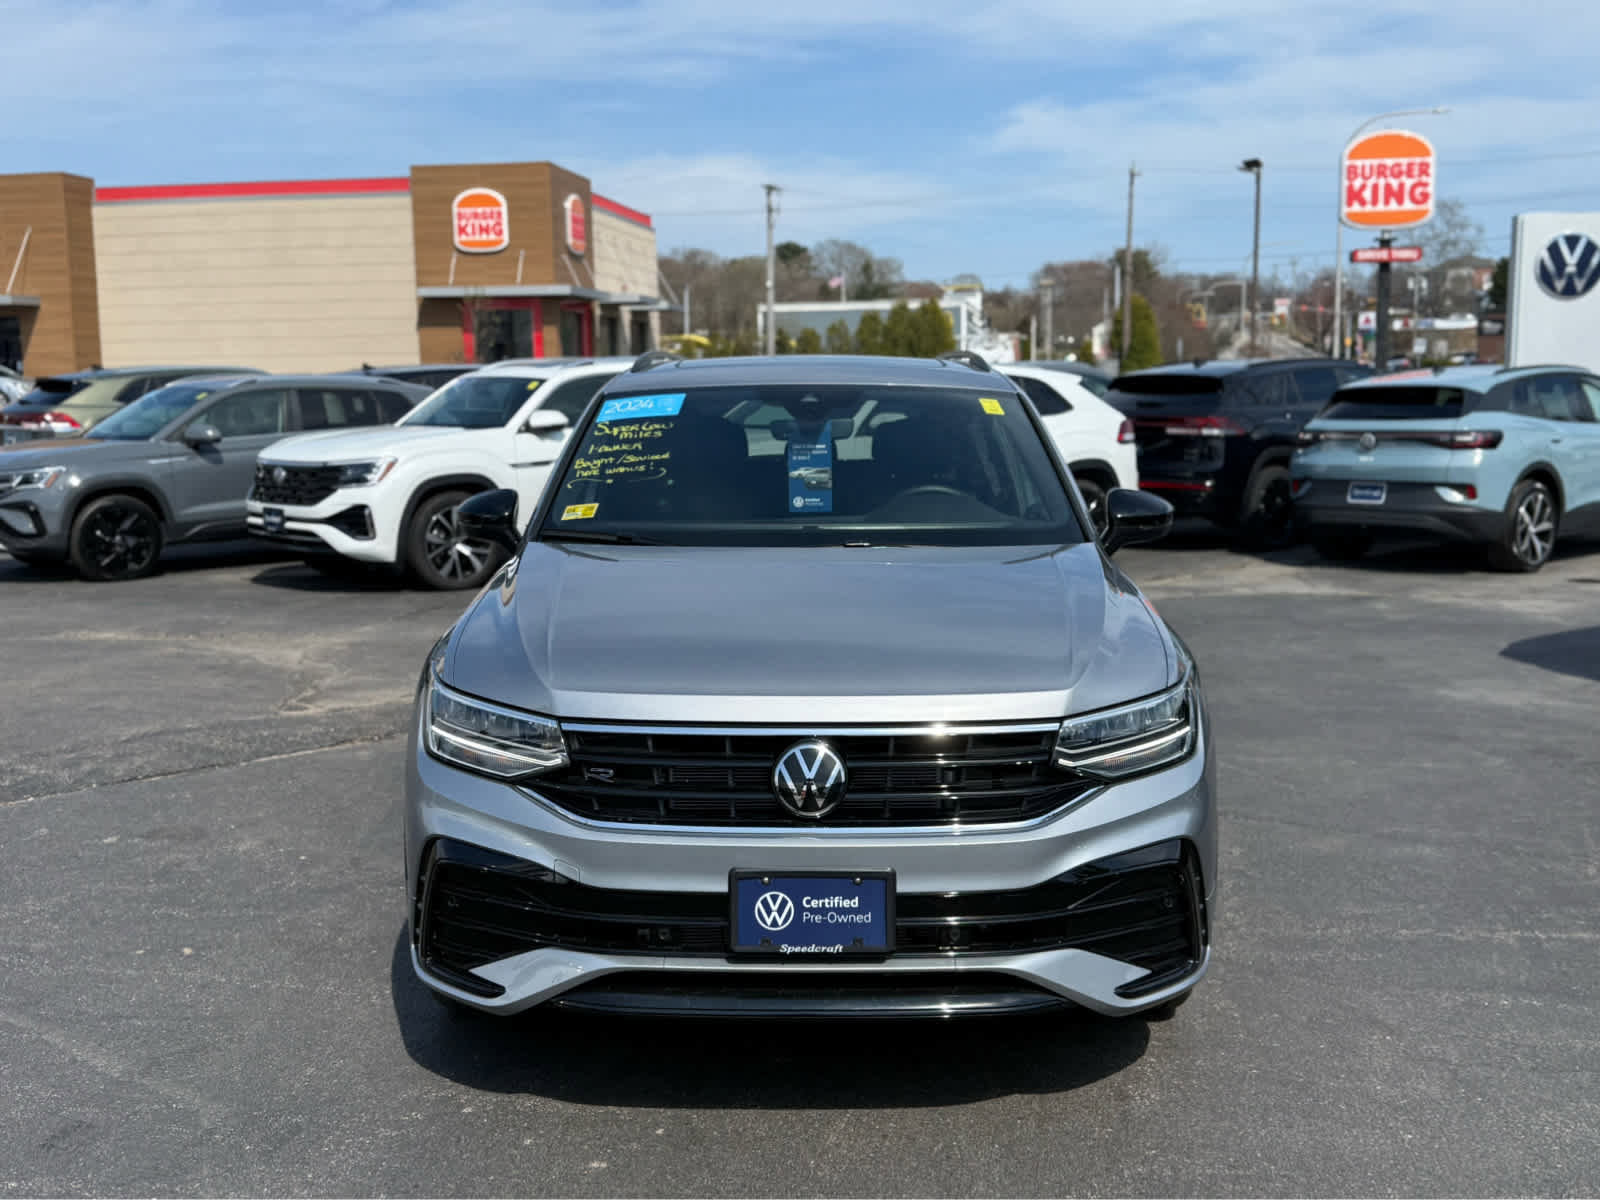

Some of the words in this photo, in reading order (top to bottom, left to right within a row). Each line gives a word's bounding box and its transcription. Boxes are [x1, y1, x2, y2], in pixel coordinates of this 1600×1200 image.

[1346, 162, 1430, 180] BURGER
[1346, 181, 1430, 207] KING
[457, 221, 503, 237] KING
[802, 896, 859, 908] Certified
[756, 892, 794, 929] VW
[802, 911, 872, 923] Pre-Owned
[779, 943, 844, 955] Speedcraft
